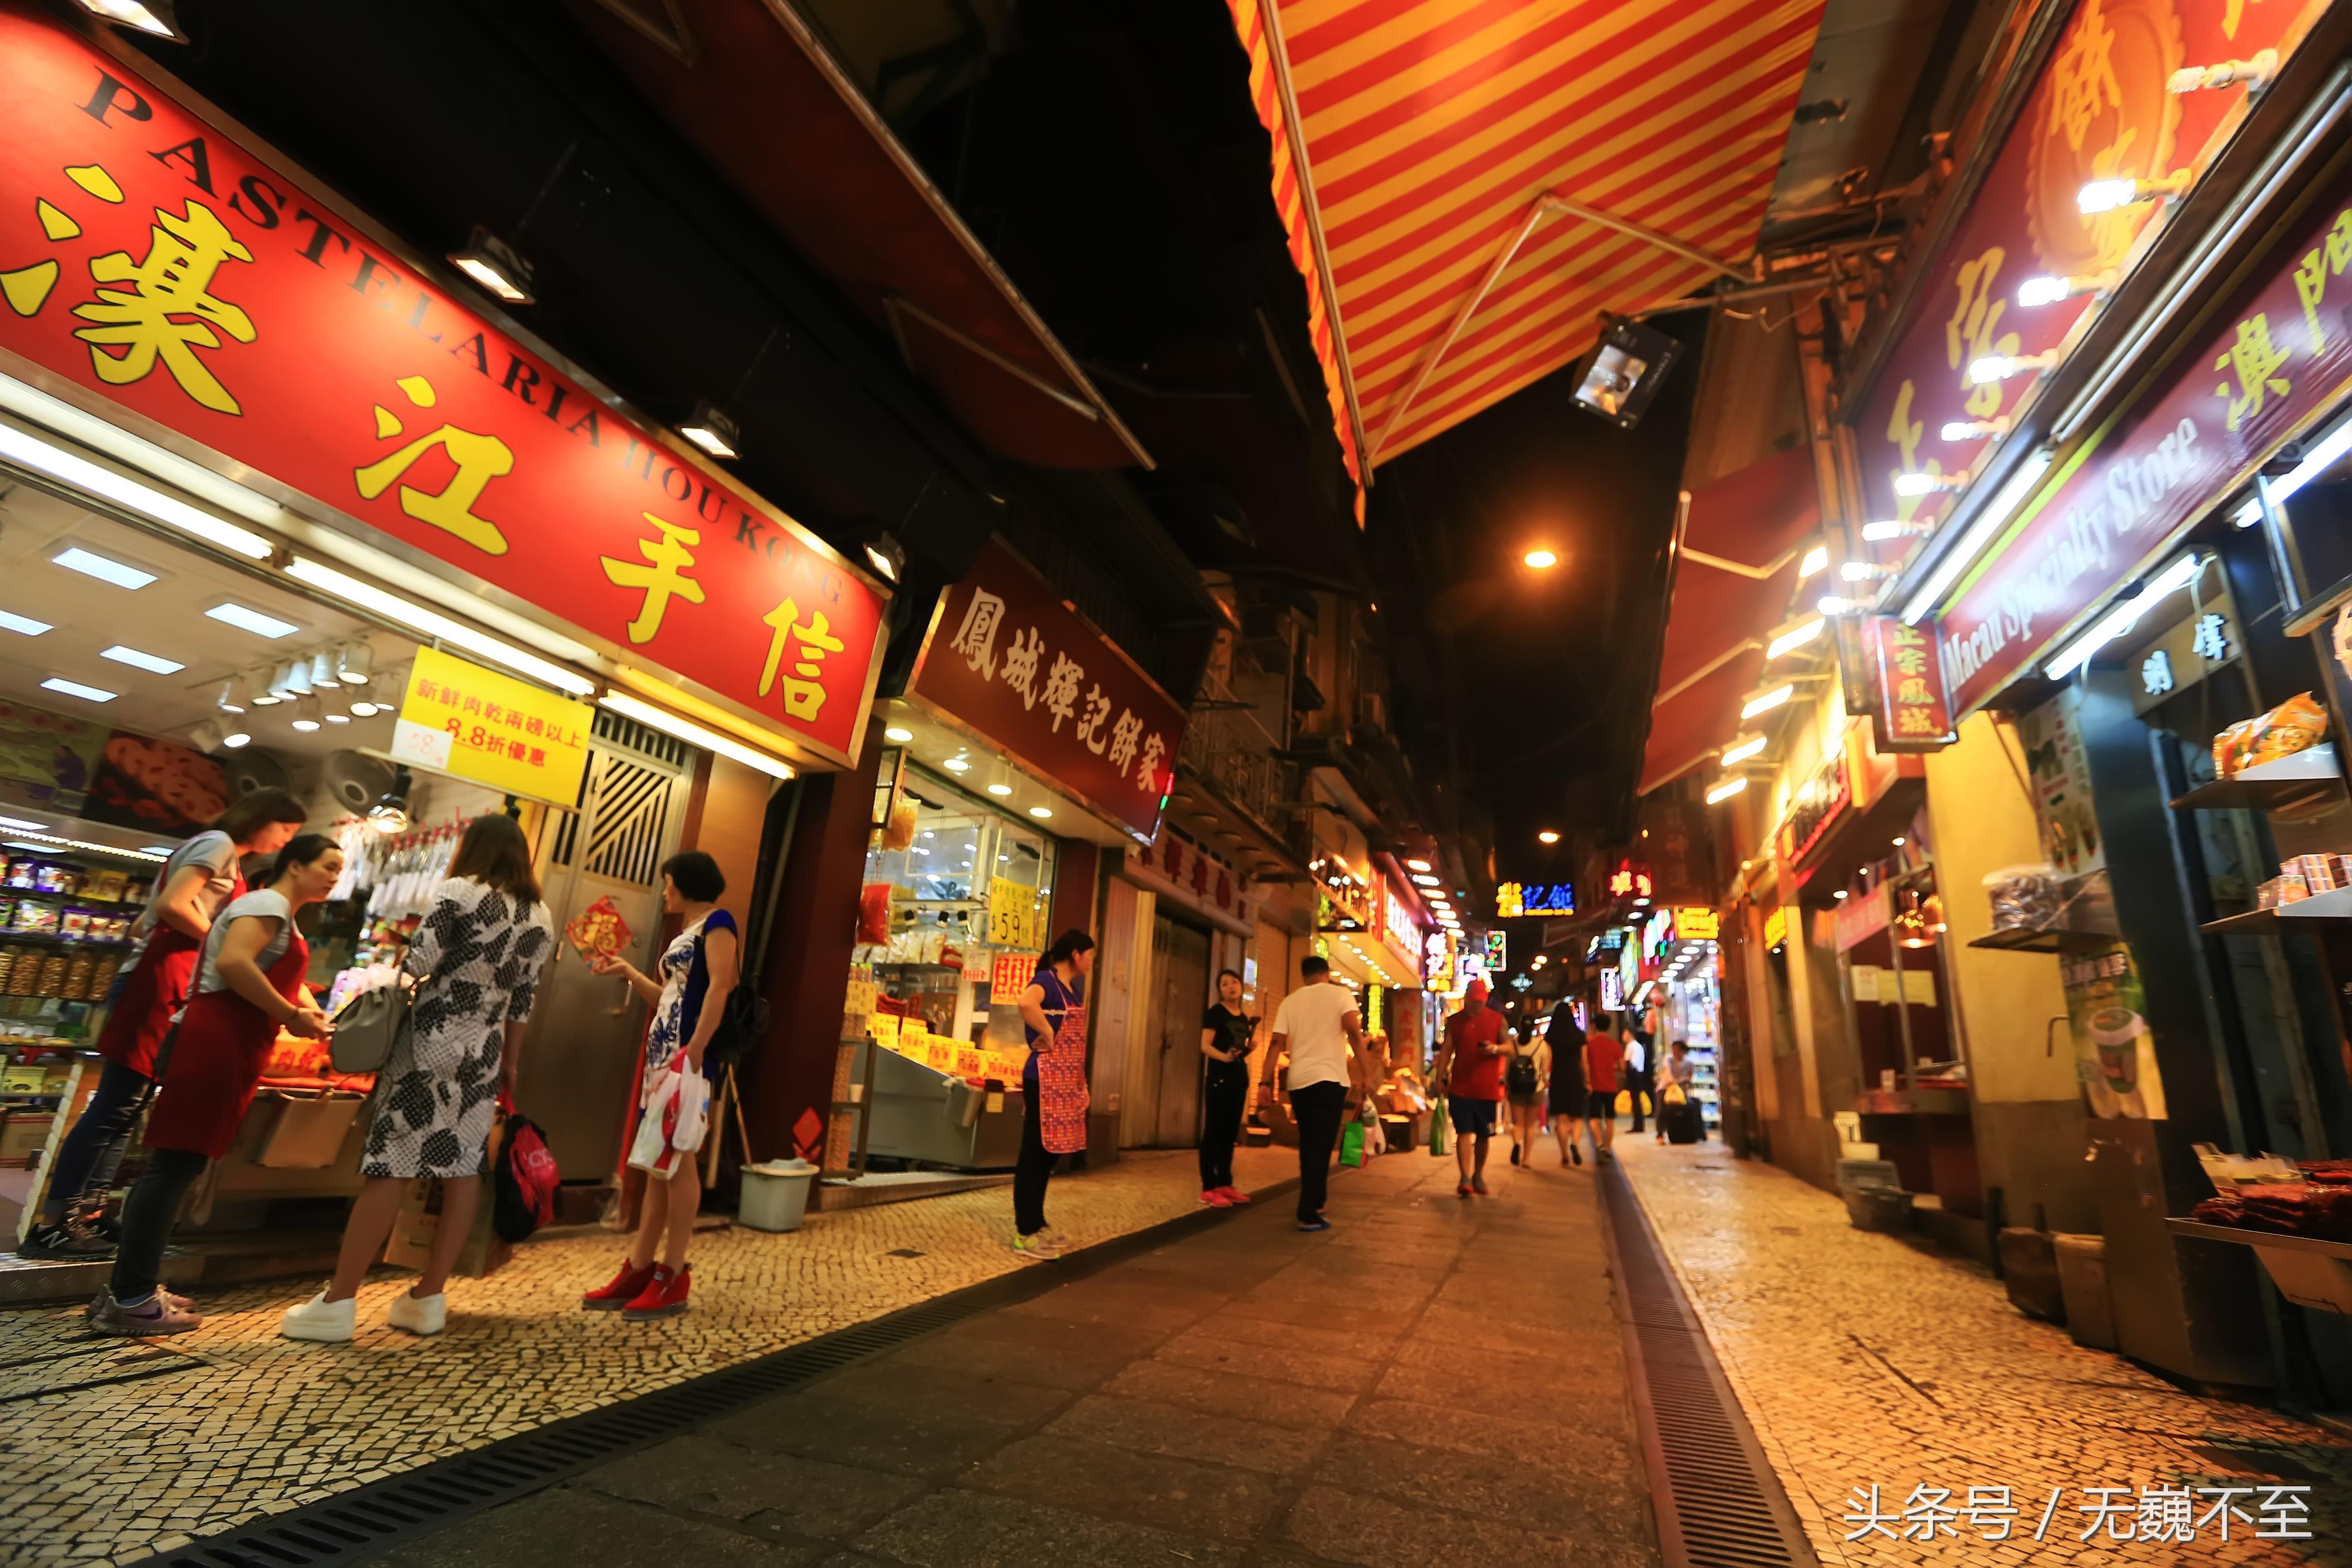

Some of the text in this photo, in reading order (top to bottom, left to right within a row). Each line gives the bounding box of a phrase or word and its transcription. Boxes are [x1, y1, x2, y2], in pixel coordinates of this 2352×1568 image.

[74, 65, 843, 606] PASTELARIA HOU KOG
[0, 163, 845, 723] 濠江手信
[1943, 609, 2007, 695] Macau
[2106, 417, 2203, 537] Store
[415, 678, 582, 750] 新鮮肉乾兩磅以上
[445, 717, 547, 768] 8.8折優惠
[950, 586, 1165, 793] 鳳城輝記餅家
[1893, 623, 1943, 735] 正宗鳳城
